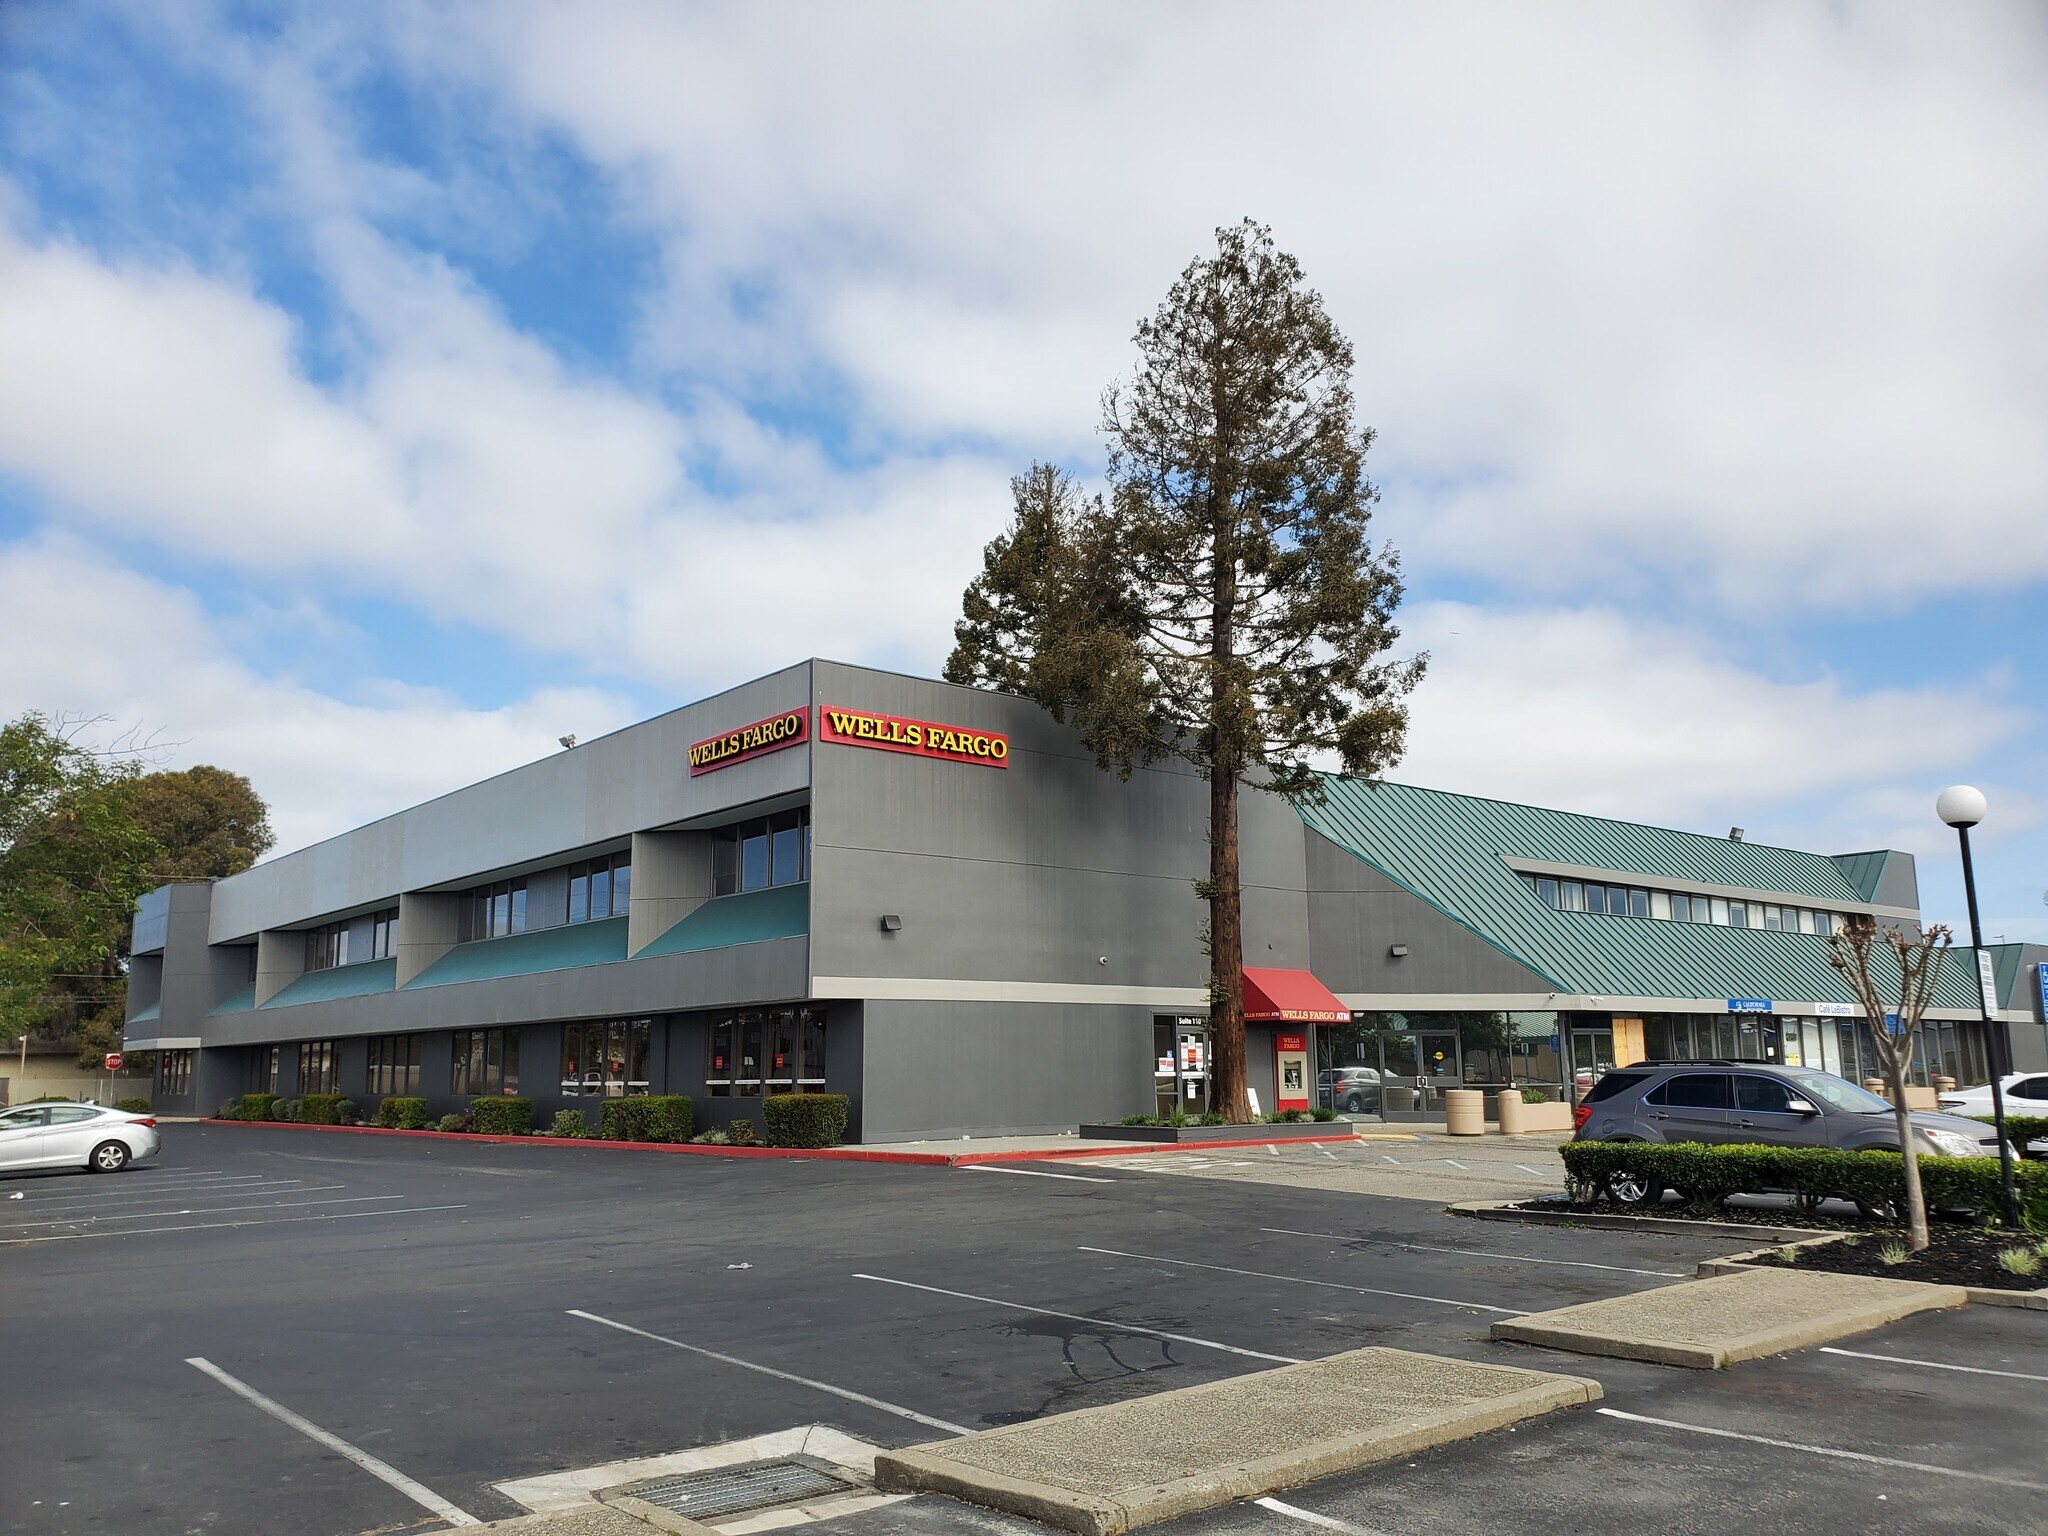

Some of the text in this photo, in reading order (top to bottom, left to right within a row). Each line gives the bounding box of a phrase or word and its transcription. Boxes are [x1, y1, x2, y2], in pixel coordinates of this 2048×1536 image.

[828, 710, 1009, 759] WELLS FARGO
[688, 714, 797, 767] WELLS FARGO
[1819, 1004, 1831, 1014] Café
[1281, 1010, 1349, 1020] WELLS FARGO ATM
[1178, 1017, 1192, 1025] Suite
[107, 1058, 121, 1066] STOP
